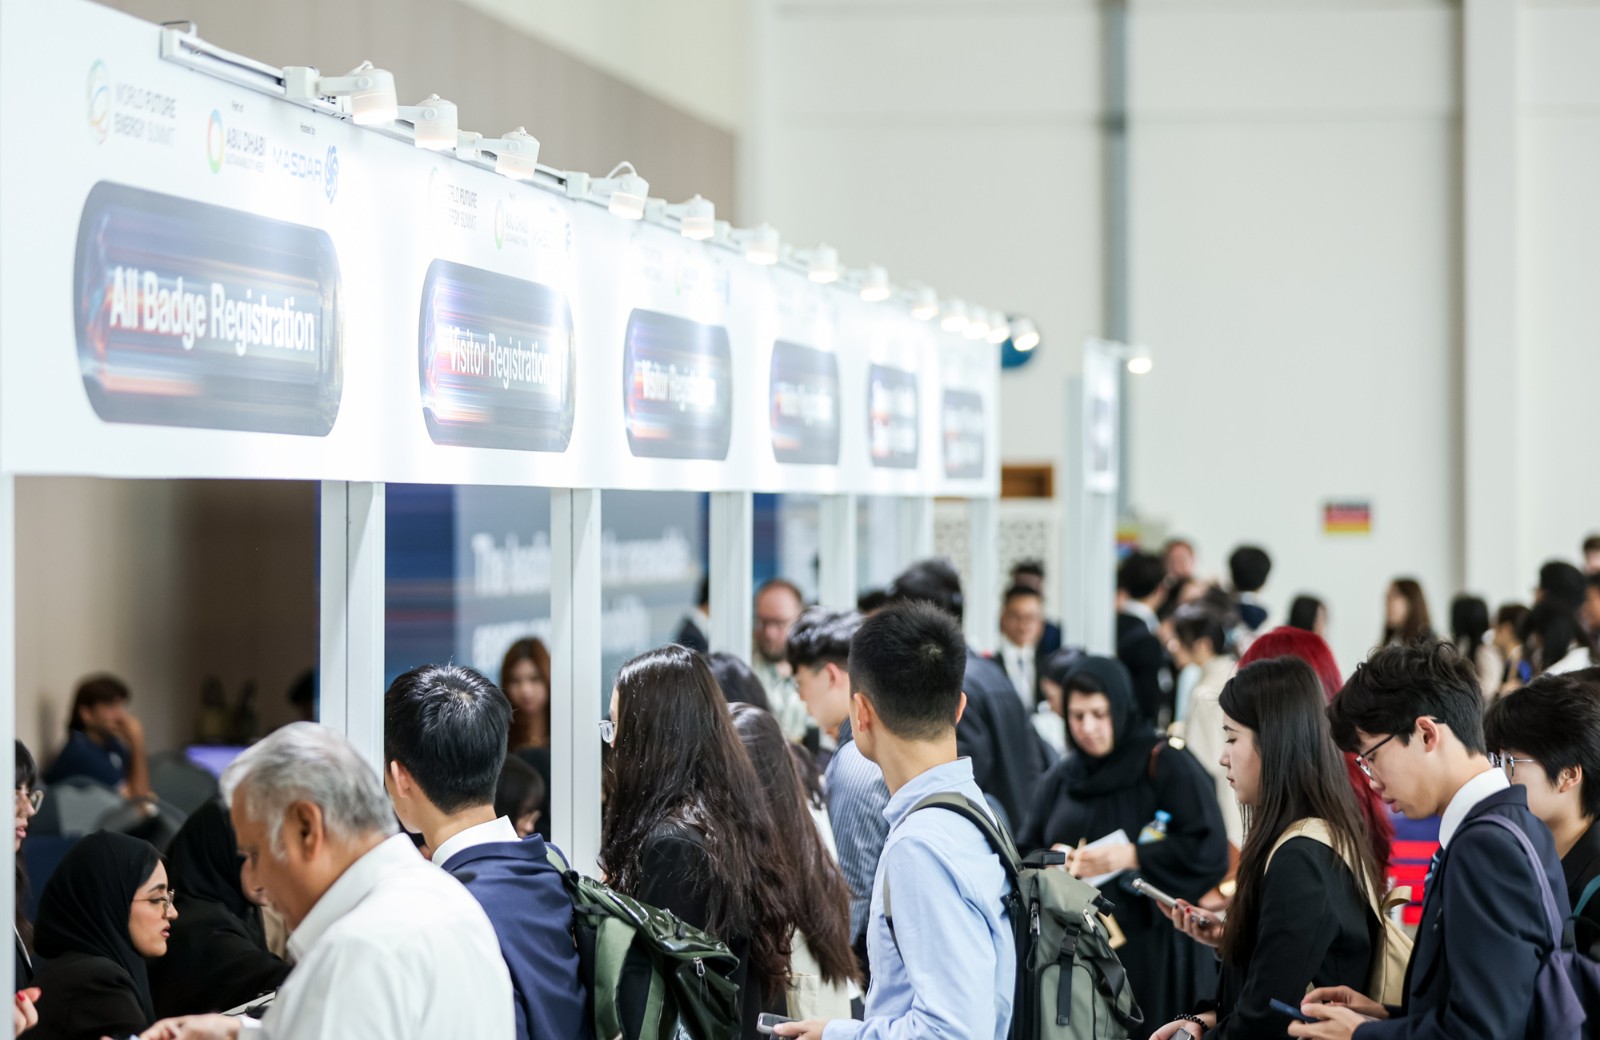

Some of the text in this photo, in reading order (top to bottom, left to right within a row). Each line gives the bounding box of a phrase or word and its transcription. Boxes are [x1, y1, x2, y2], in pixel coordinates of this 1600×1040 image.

[116, 83, 176, 119] WORLD FUTURE
[115, 113, 175, 146] ENERGY SUMMIT
[226, 127, 267, 156] ABU DHABI
[272, 146, 322, 184] MASDAR
[460, 187, 477, 209] FUTURE
[109, 265, 315, 356] All Badge Registration
[448, 325, 550, 390] Visitor Registration
